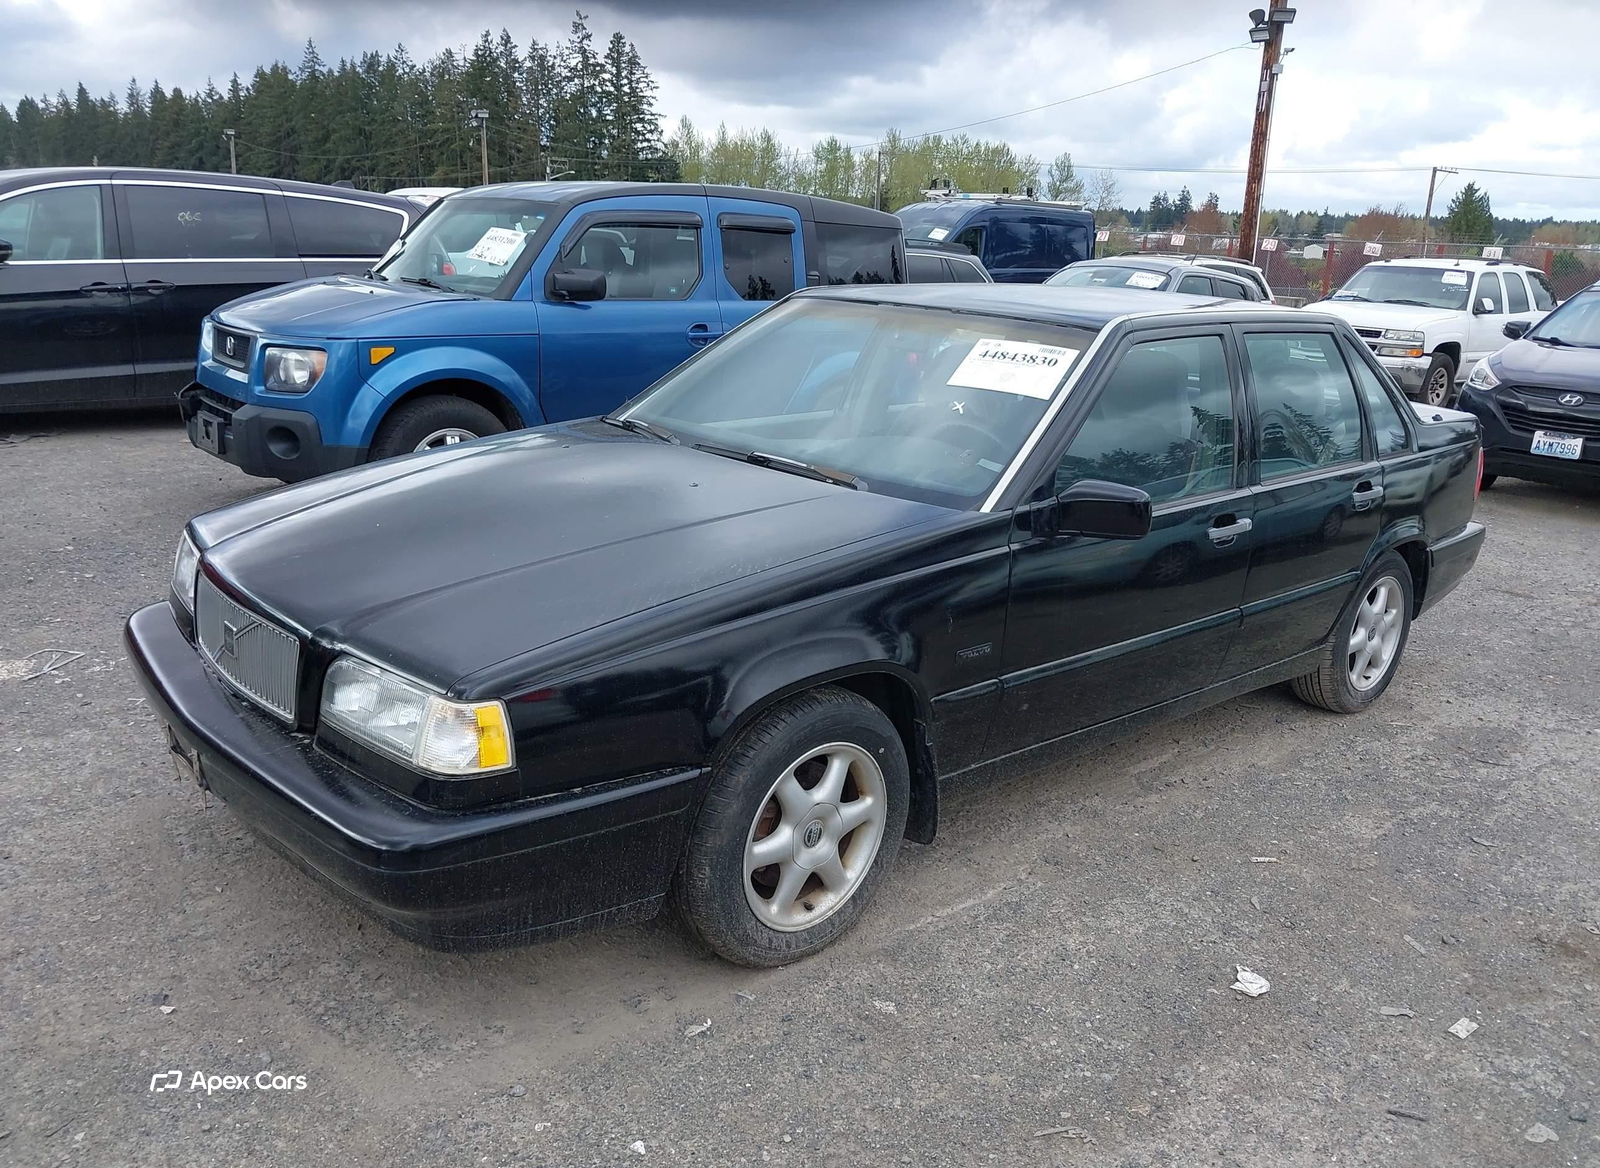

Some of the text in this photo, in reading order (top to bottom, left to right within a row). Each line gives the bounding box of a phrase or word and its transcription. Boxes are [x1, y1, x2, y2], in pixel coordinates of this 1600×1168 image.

[1098, 231, 1108, 241] 27
[1172, 235, 1184, 245] 28
[1263, 240, 1277, 250] 29
[978, 349, 1059, 368] 44843830
[1534, 439, 1579, 456] AYM7996
